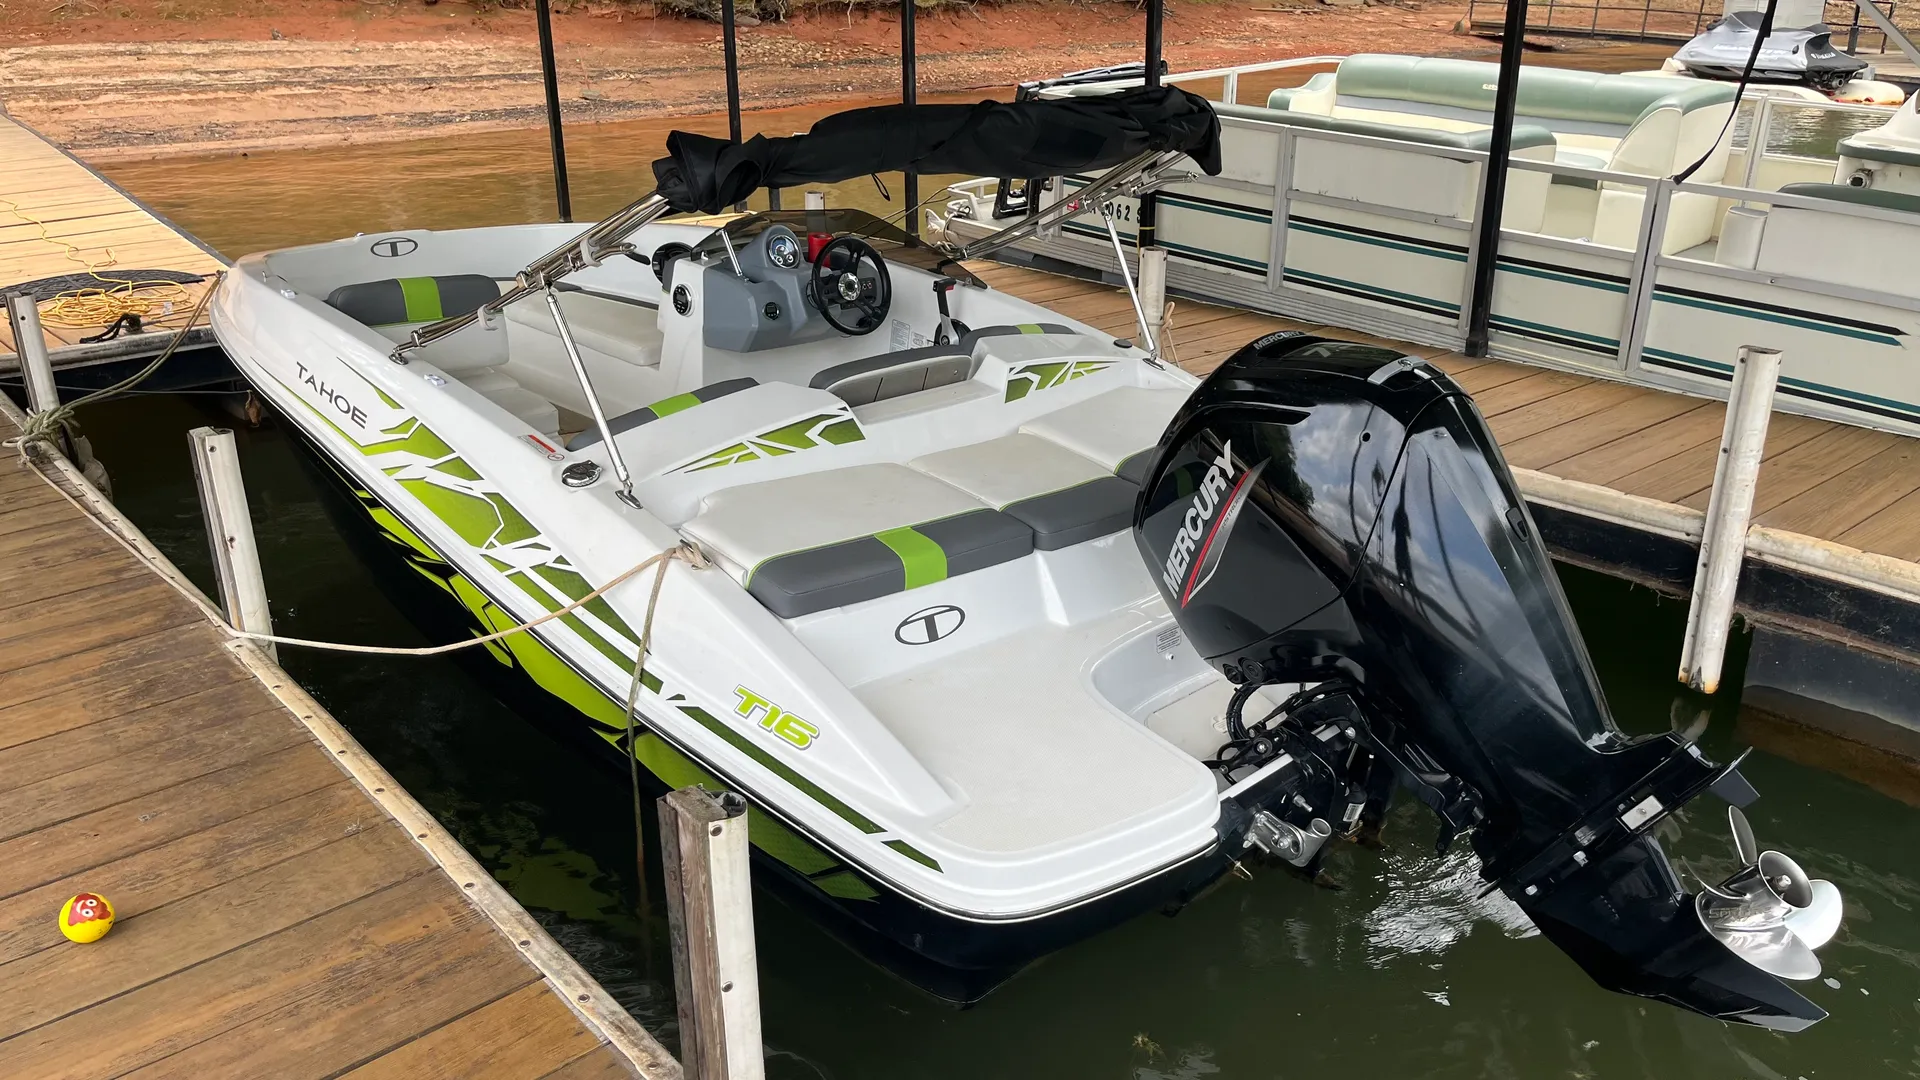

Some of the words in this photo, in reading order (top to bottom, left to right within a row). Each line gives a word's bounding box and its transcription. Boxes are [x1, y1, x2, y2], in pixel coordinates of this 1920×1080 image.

[1253, 330, 1301, 350] MERCURY
[296, 361, 368, 430] TAHOE
[1163, 439, 1235, 599] MERCURY
[733, 684, 820, 751] T16
